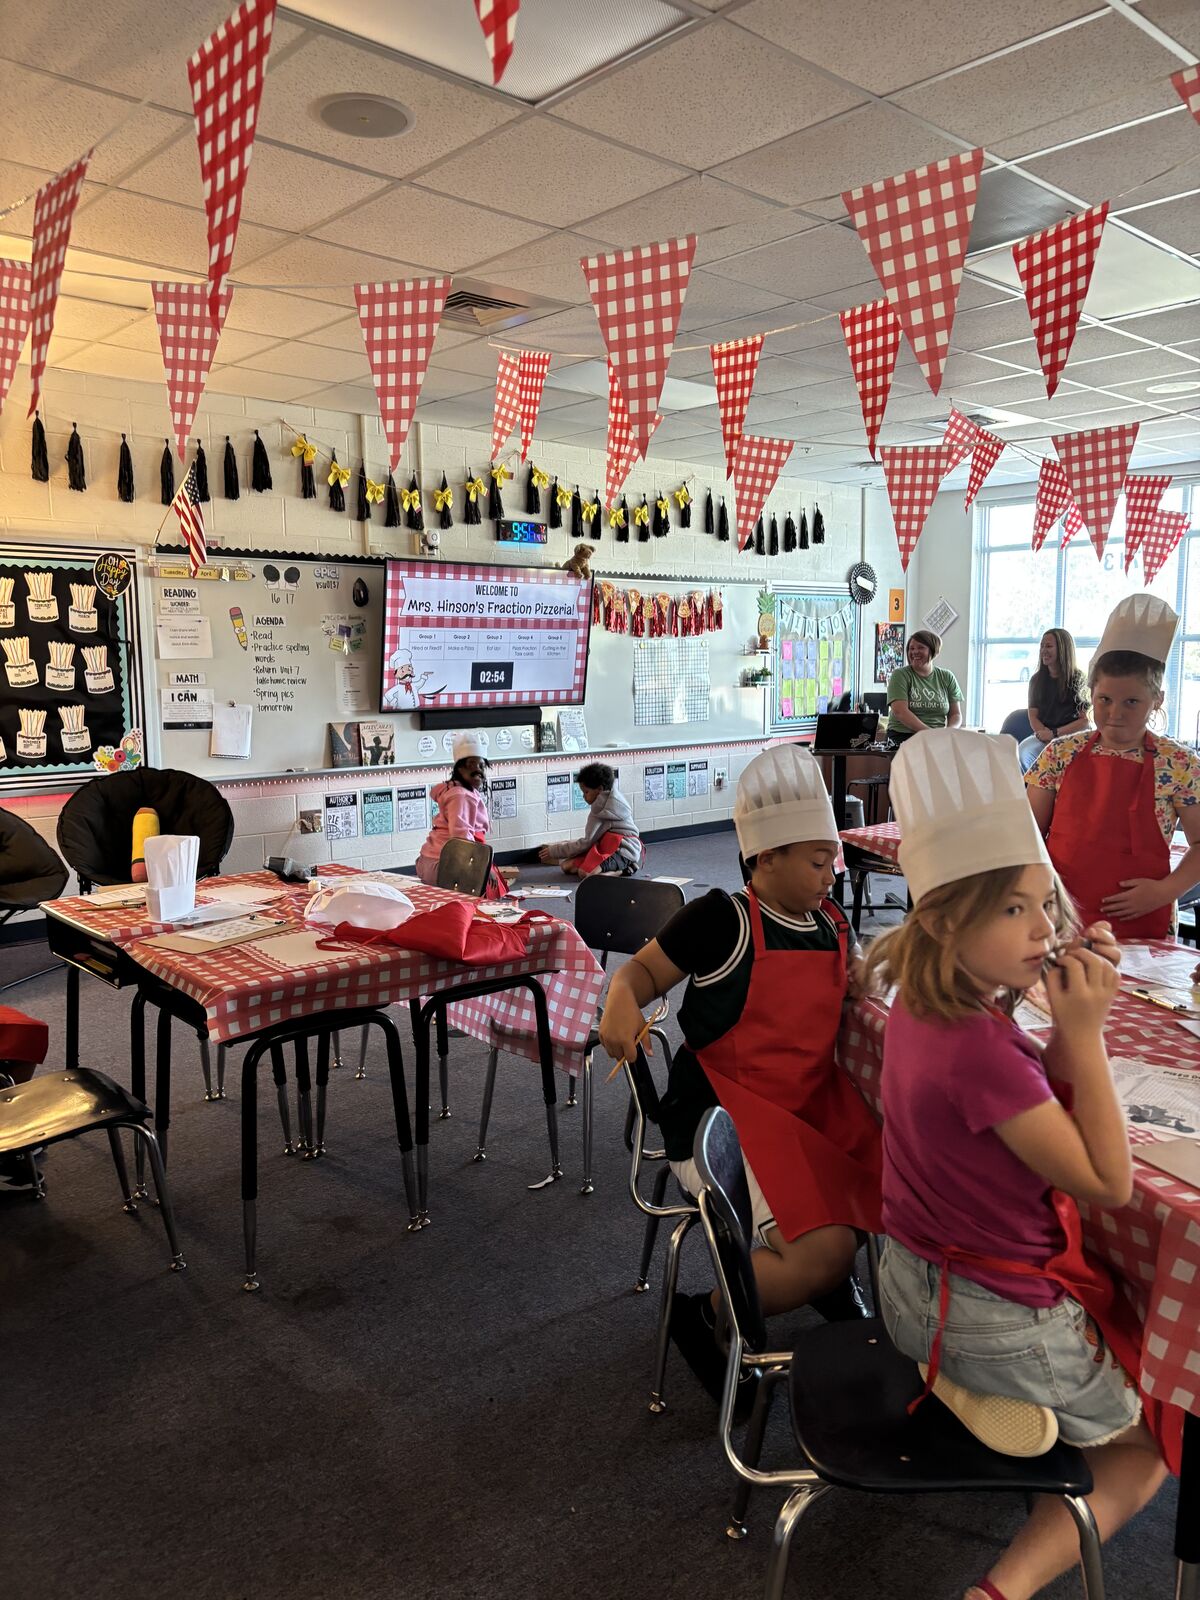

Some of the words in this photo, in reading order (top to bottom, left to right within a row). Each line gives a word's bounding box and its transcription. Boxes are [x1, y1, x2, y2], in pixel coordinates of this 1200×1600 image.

[108, 556, 118, 567] OH
[97, 557, 128, 580] Happy
[314, 566, 339, 580] epic!
[100, 573, 120, 590] Day
[163, 588, 196, 599] READING
[475, 584, 509, 597] WELCOME
[510, 586, 518, 597] TO
[271, 593, 281, 604] 16
[286, 593, 295, 604] 17
[407, 600, 434, 613] Mrs.
[437, 601, 484, 614] Hinson's
[487, 602, 532, 615] Fraction
[534, 603, 575, 616] Pizzeria!
[894, 598, 900, 611] 3
[255, 616, 285, 626] AGENDA
[253, 630, 273, 640] Read
[254, 642, 283, 652] Practice
[286, 643, 310, 656] spelling
[255, 654, 276, 663] words
[255, 665, 277, 674] Return
[280, 666, 293, 674] Unit
[294, 666, 300, 675] 7
[176, 674, 199, 684] MATH
[287, 677, 307, 685] review
[479, 670, 505, 683] 02:54
[255, 688, 279, 702] Spring
[281, 690, 294, 702] pics
[257, 703, 293, 712] tomorrow
[492, 781, 505, 790] MAIN
[505, 780, 515, 788] IDEA
[415, 789, 425, 797] VIEW
[329, 794, 354, 804] AUTHOR'S
[365, 794, 391, 804] INFERENCES
[328, 814, 340, 826] PIE
